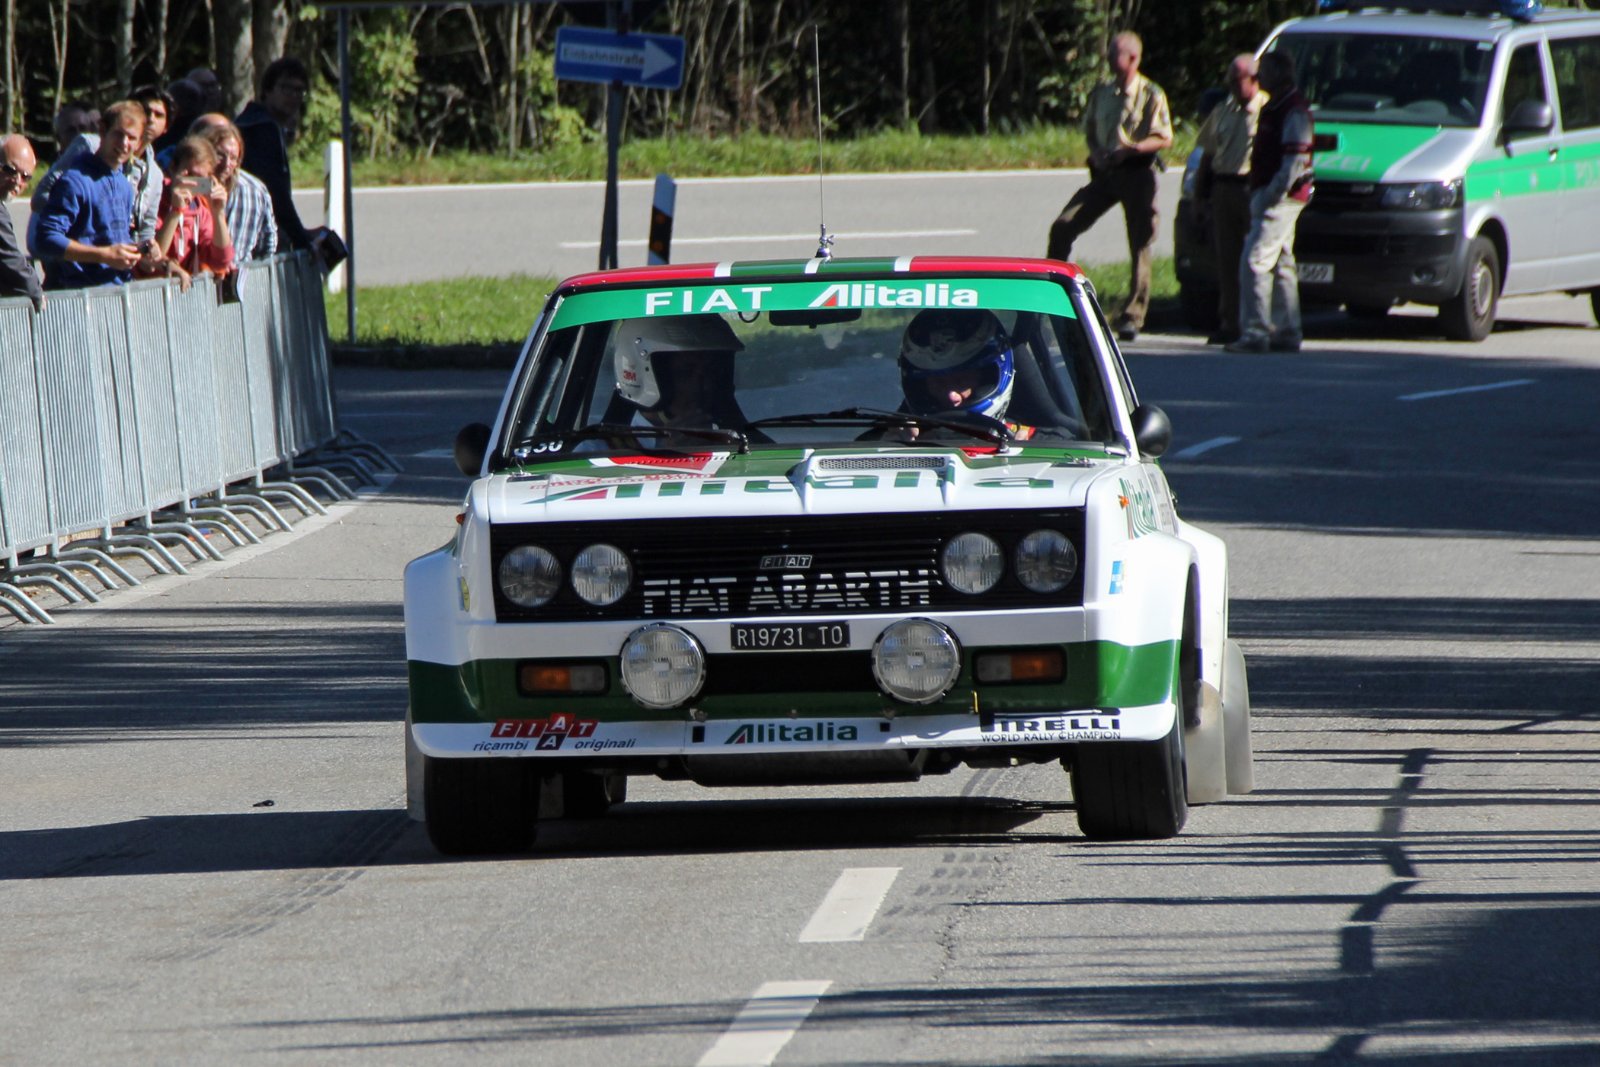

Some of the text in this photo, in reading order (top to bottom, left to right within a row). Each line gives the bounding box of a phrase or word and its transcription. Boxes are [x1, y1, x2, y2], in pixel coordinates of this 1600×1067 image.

[645, 286, 773, 316] FIAT
[808, 283, 979, 309] Alitalia
[761, 555, 813, 569] FIAT
[643, 569, 930, 614] FIAT ABARTH
[736, 625, 843, 647] R19731 TO
[495, 714, 595, 737] FIAT
[980, 707, 1121, 733] PIRELLI
[473, 740, 529, 751] ricambi
[574, 738, 637, 752] originali
[724, 722, 858, 745] Alitalia
[981, 730, 1121, 742] WORLD RALLY CHAMPION
